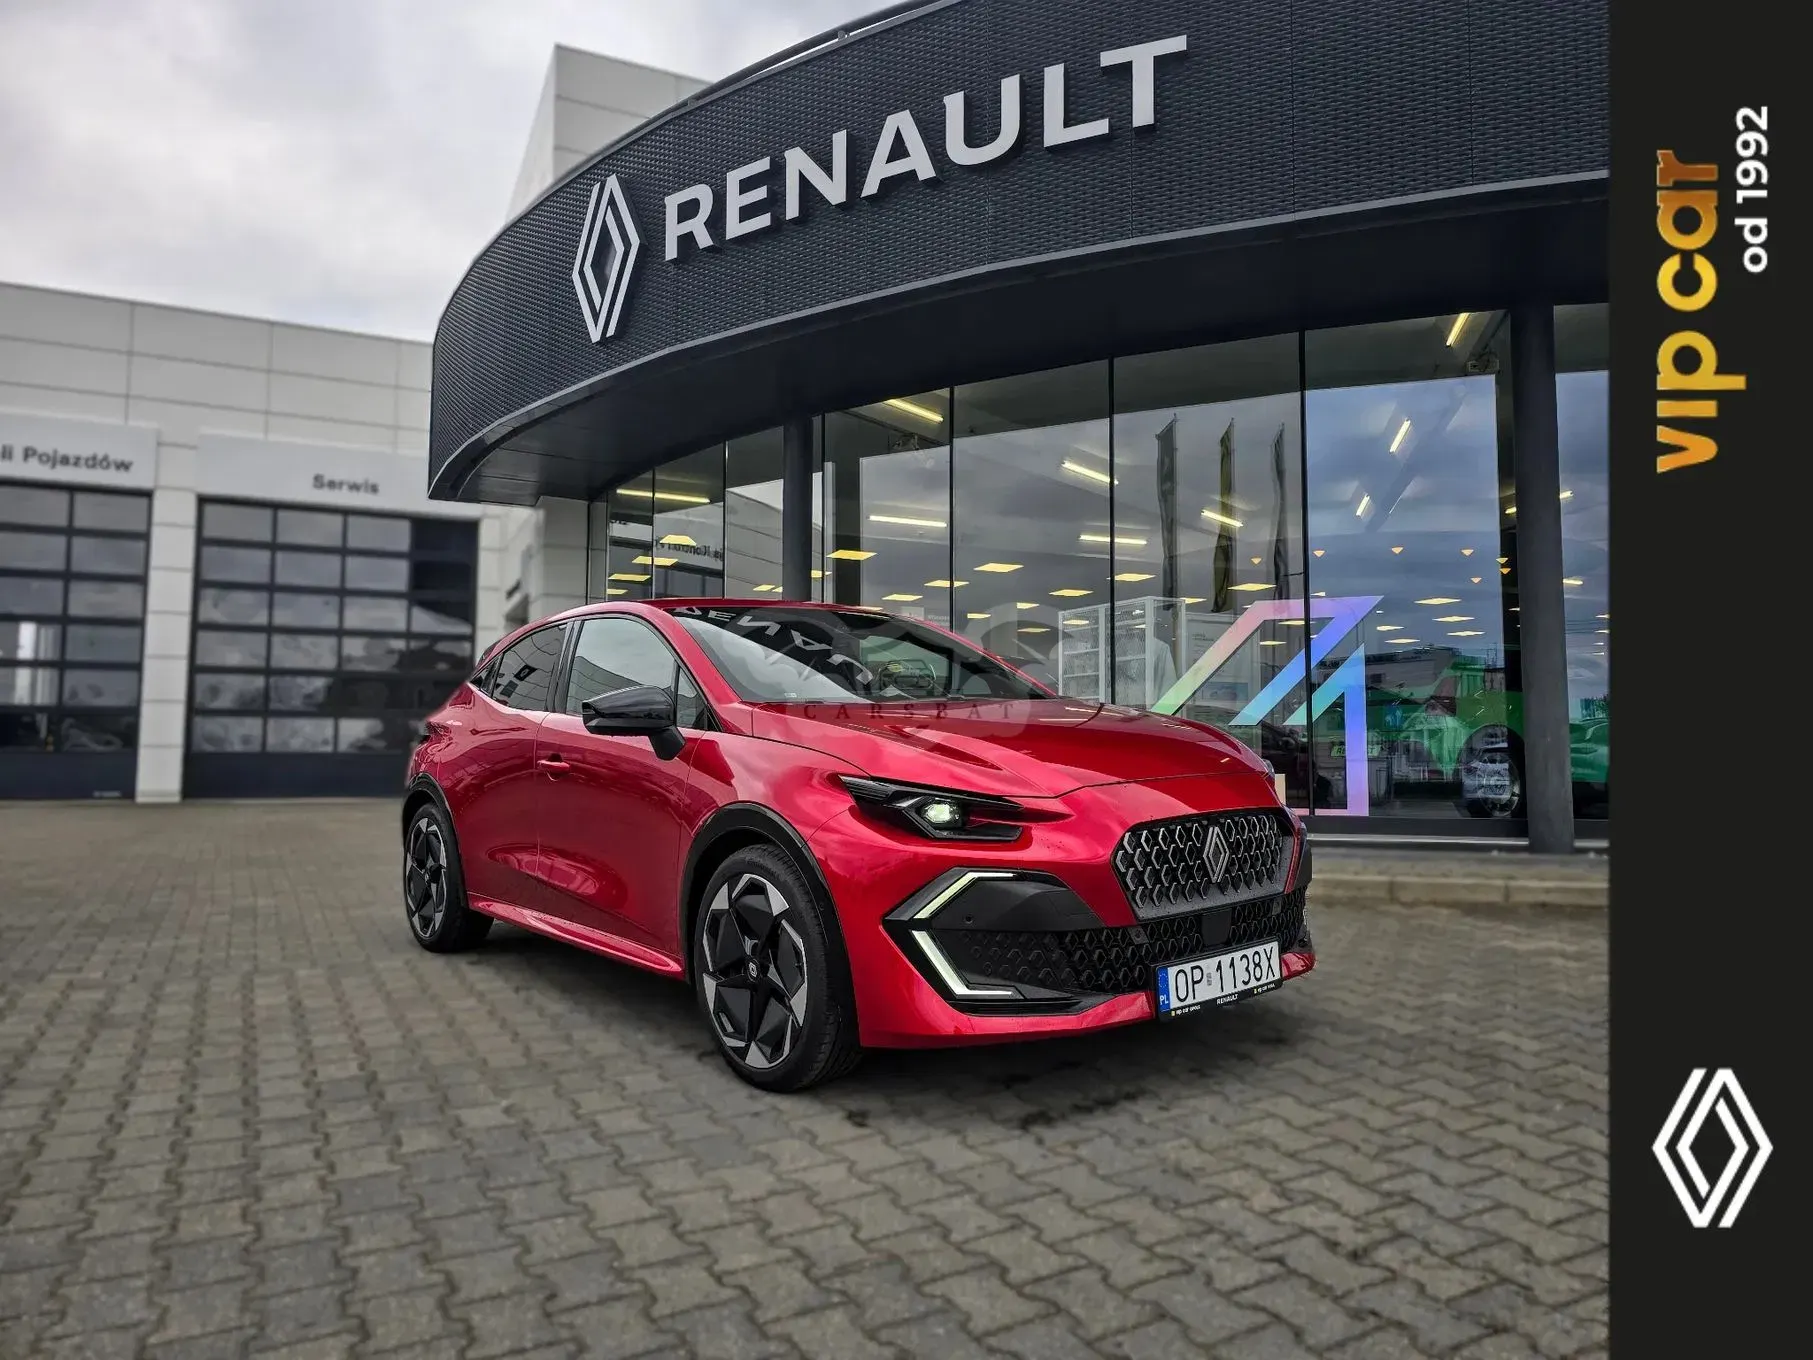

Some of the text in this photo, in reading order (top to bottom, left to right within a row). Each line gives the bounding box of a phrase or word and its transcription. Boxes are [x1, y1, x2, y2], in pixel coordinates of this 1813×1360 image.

[664, 35, 1188, 262] RENAULT
[23, 445, 134, 472] Pojazdów
[313, 474, 379, 496] Serwis
[1174, 946, 1276, 1002] OP 1138X
[1159, 994, 1169, 1006] PL
[1216, 993, 1239, 1005] RENAULT
